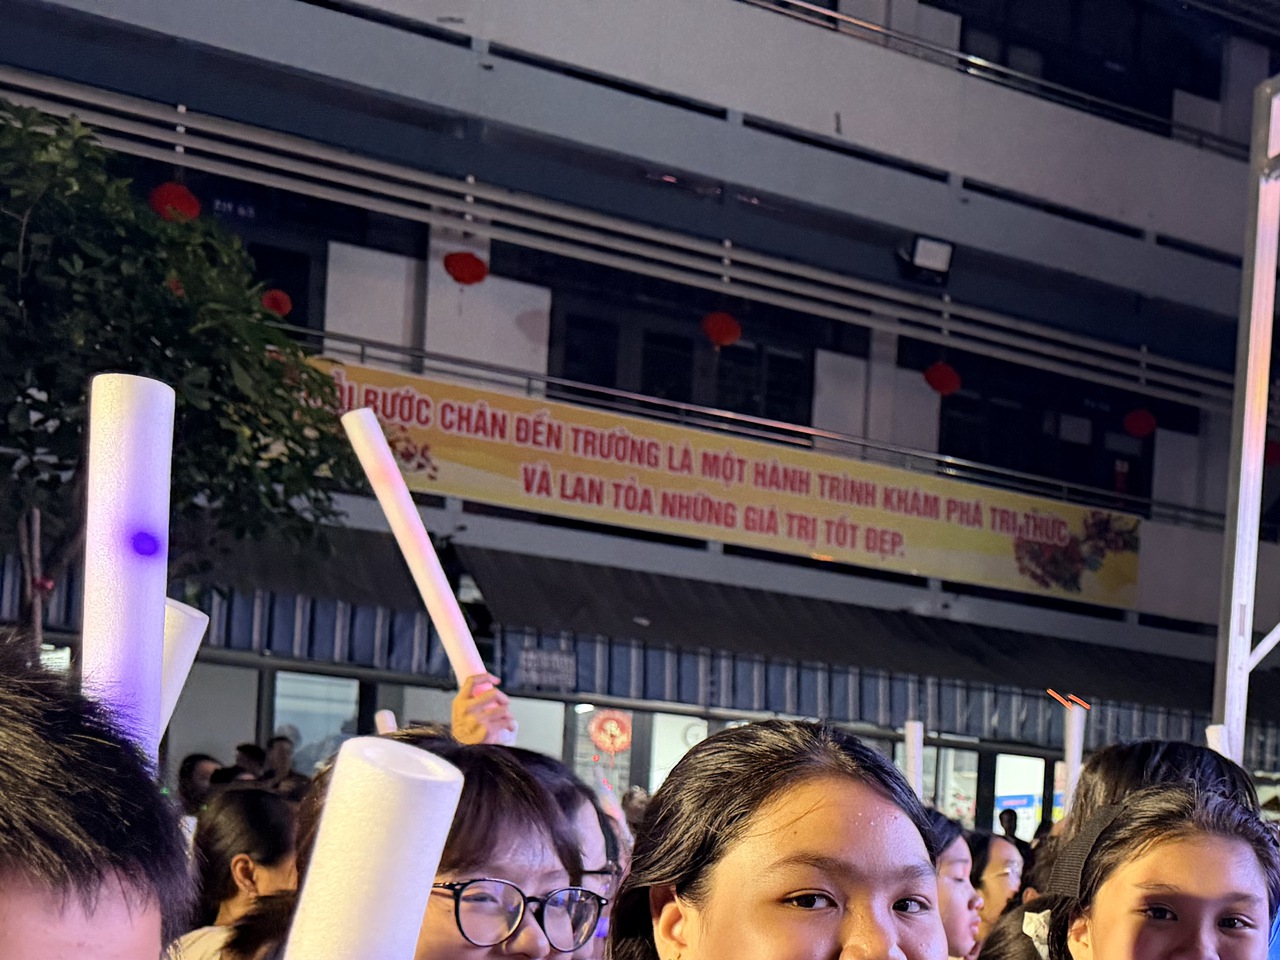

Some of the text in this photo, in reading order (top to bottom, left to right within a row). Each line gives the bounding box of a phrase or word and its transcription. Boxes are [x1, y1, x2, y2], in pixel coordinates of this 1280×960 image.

[364, 385, 432, 426] BƯỚC
[440, 401, 507, 440] CHÂN
[515, 411, 563, 450] ĐẾN
[570, 426, 662, 469] TRƯỜNG
[667, 442, 694, 475] LÀ
[701, 450, 747, 486] MỘT
[753, 459, 812, 494] HÀNH
[817, 473, 877, 507] TRÌNH
[882, 486, 940, 520] KHÁM
[946, 498, 983, 529] PHÁ
[522, 463, 552, 497] VÀ
[559, 473, 605, 506] LAN
[660, 490, 737, 528] NHỮNG
[743, 504, 779, 536] GIÁ
[785, 512, 818, 547] TRỊ
[824, 515, 859, 549] TỐT
